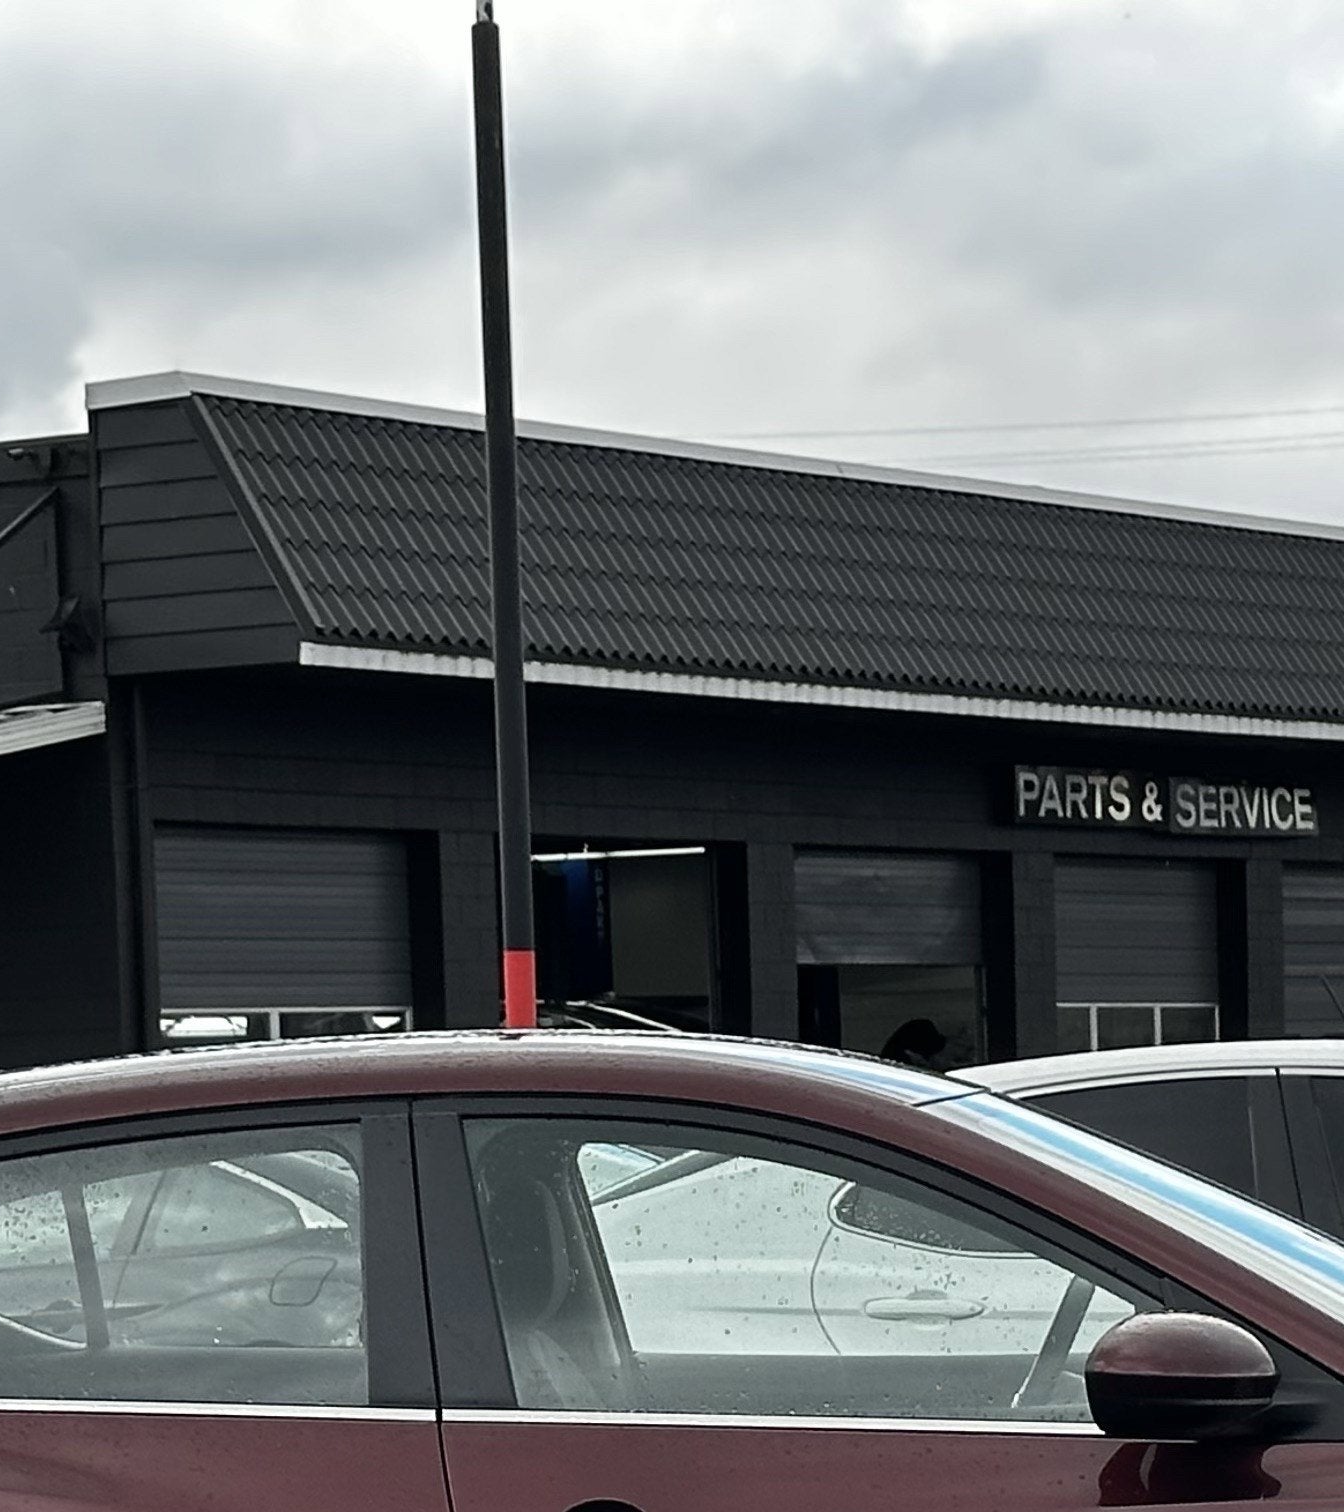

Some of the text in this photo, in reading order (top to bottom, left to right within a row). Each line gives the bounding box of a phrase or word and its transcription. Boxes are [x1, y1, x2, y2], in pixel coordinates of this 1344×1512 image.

[1017, 771, 1314, 830] PARTS & SERVICE
